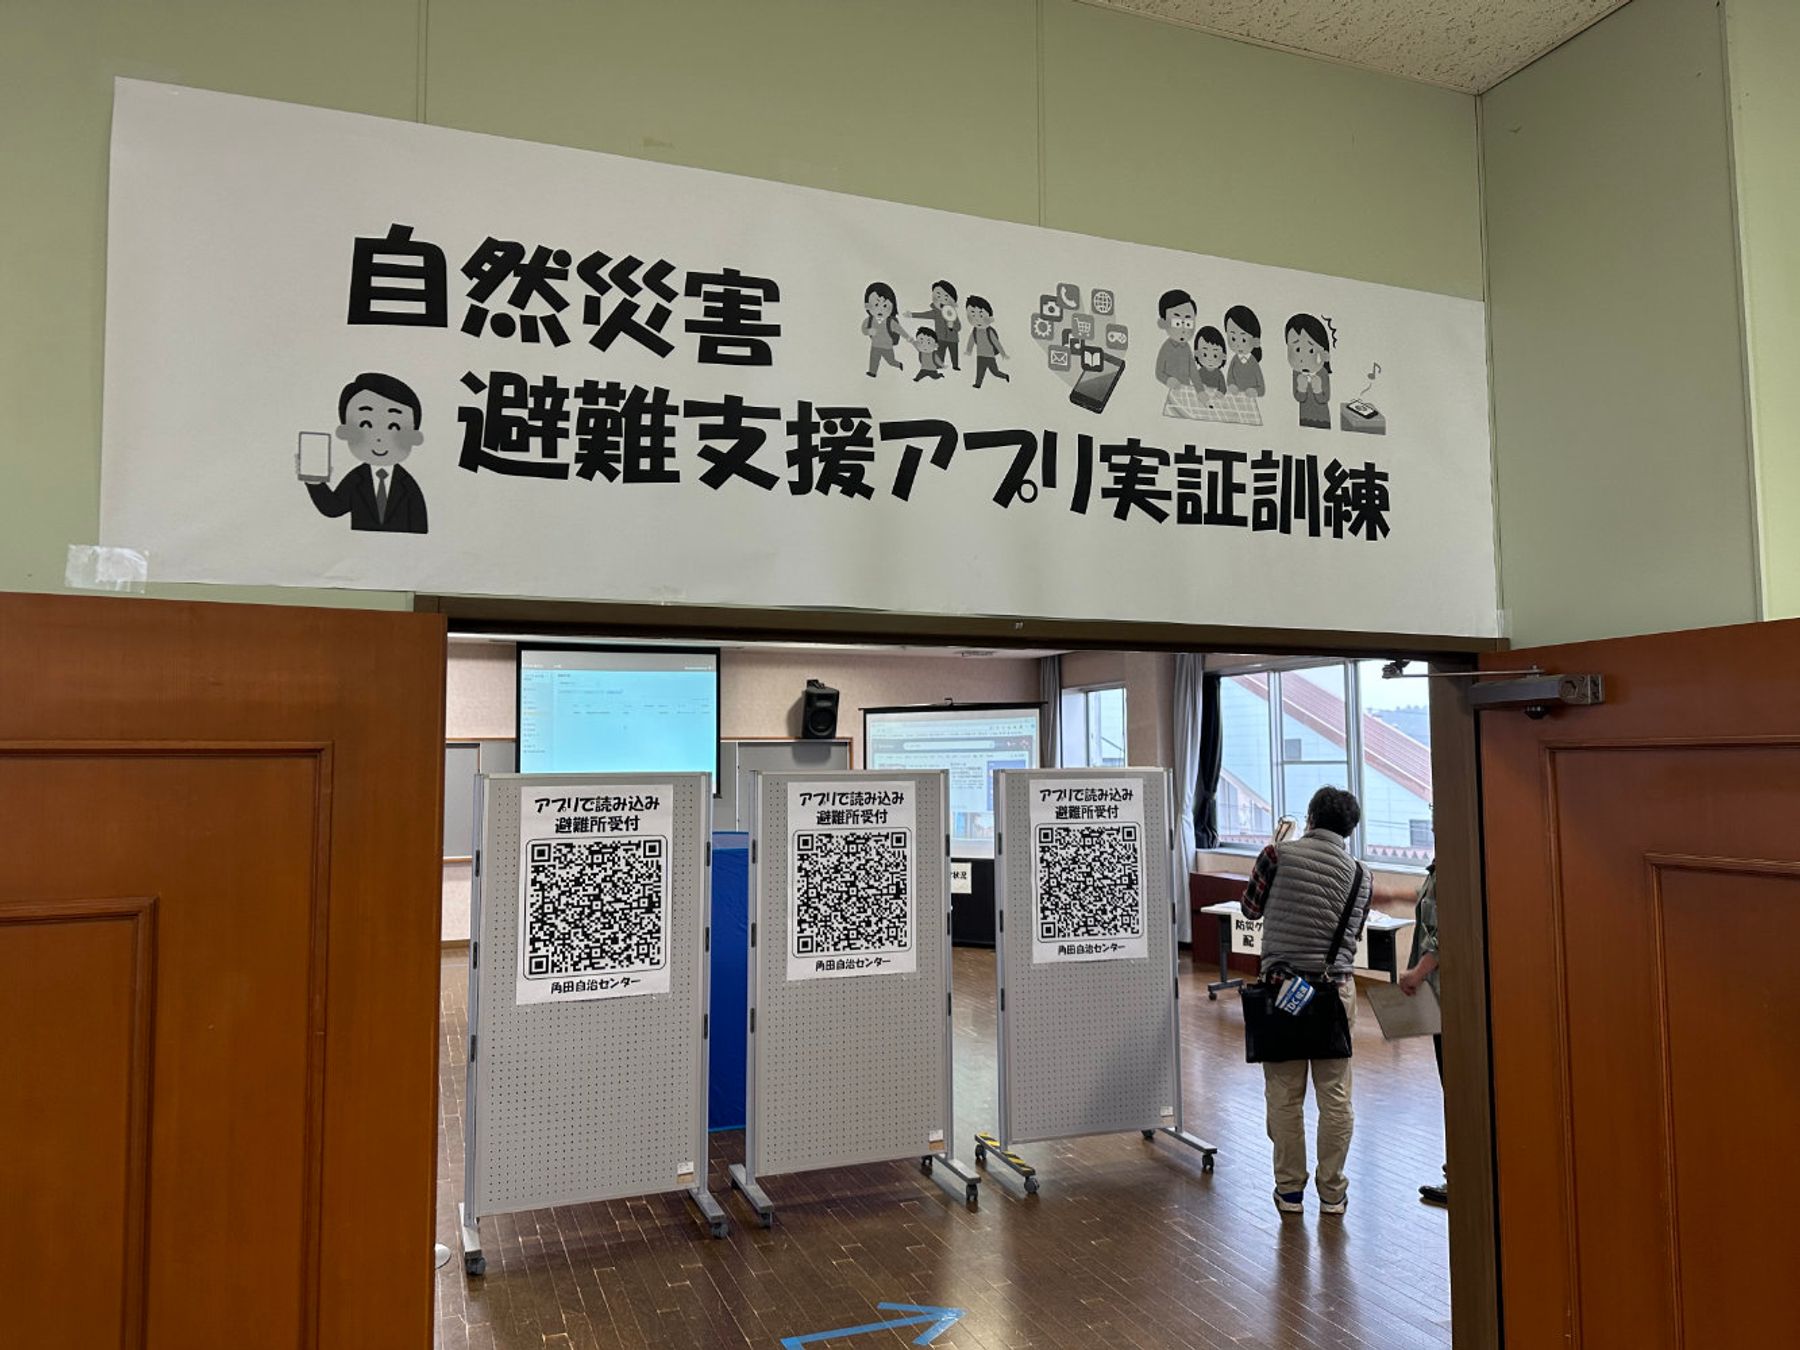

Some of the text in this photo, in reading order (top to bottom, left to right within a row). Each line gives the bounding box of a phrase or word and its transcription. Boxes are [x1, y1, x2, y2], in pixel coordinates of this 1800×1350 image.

[347, 223, 782, 367] 自然災害
[457, 370, 1391, 542] 避難支援アプリ実証訓練
[799, 790, 905, 807] アプリで読み込み
[1039, 787, 1134, 802] アプリで読み込み
[534, 795, 660, 814] アプリで読み込み
[1055, 804, 1119, 820] 避難所受付
[554, 814, 641, 834] 避難所受付
[816, 808, 888, 826] 避難所受付
[1058, 942, 1126, 956] 角田自治センター
[815, 957, 892, 972] 角田自治センター
[550, 976, 641, 994] 角田自治センター
